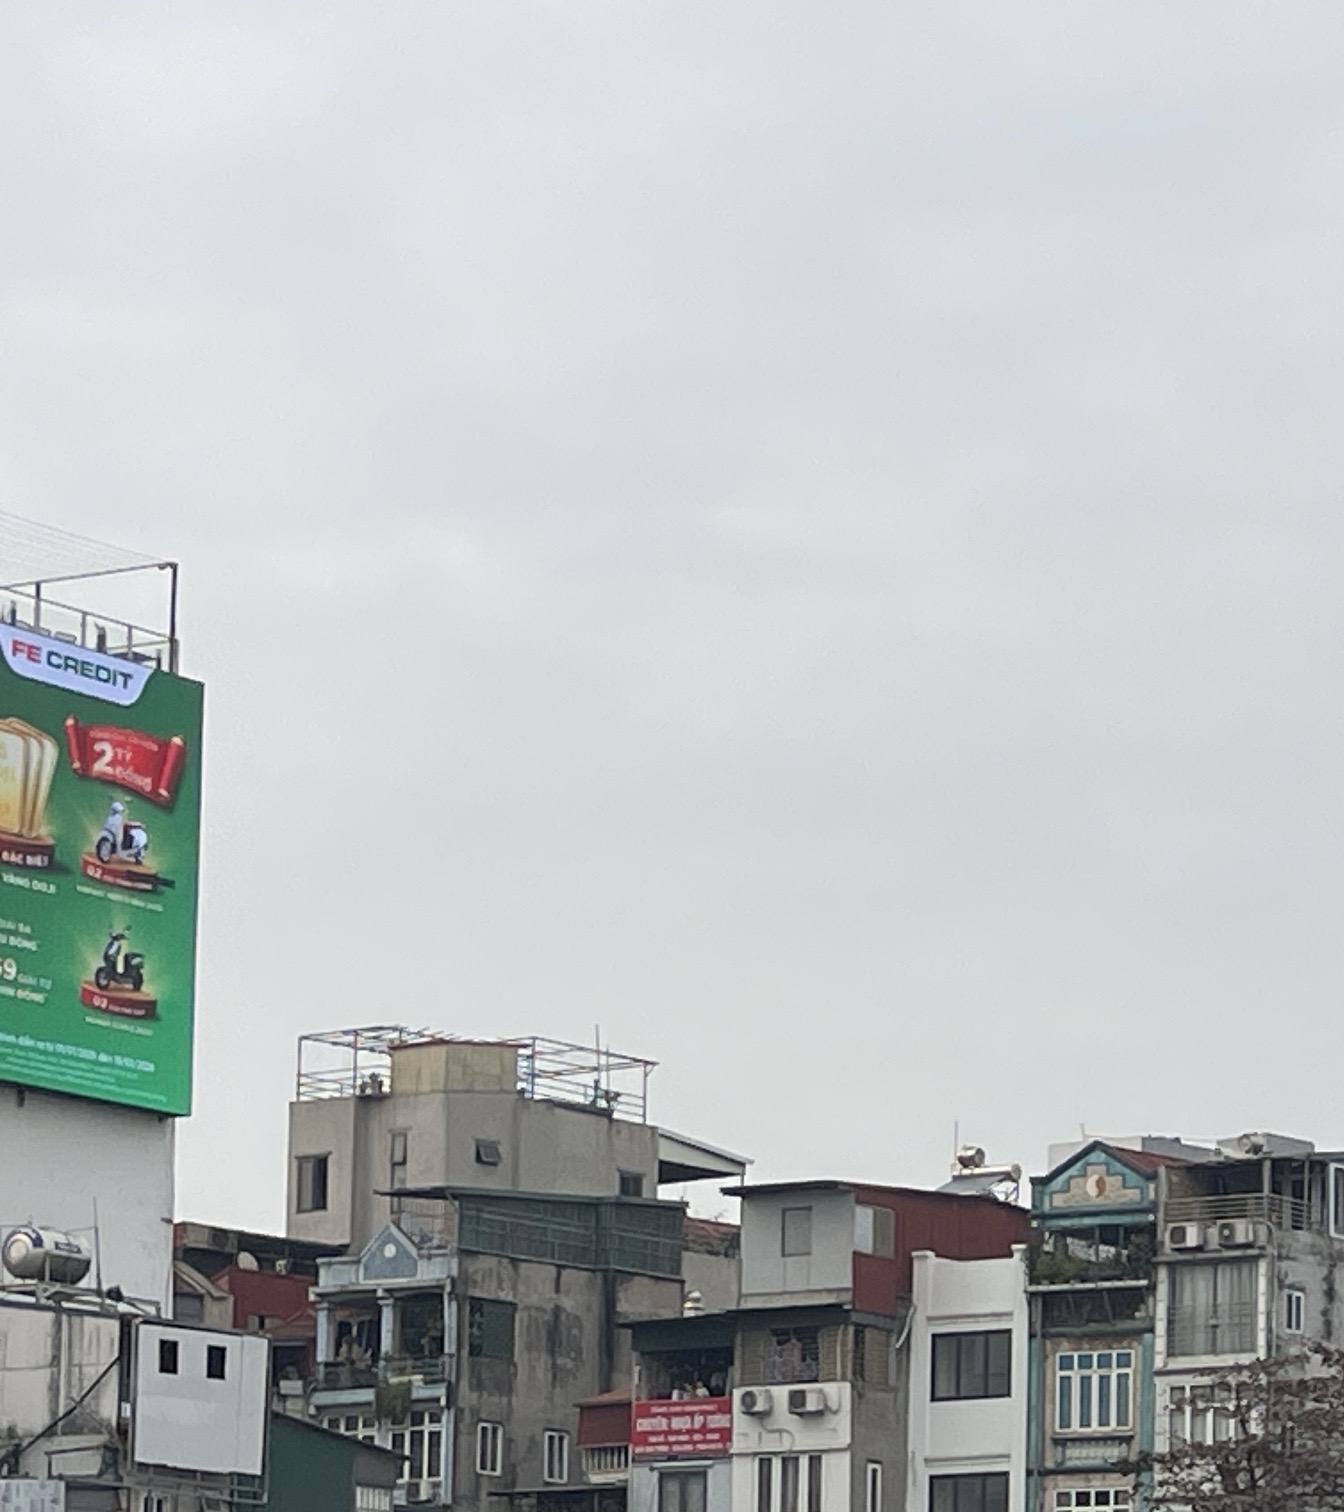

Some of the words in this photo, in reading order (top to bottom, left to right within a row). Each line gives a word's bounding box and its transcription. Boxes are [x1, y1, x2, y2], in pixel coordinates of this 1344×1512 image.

[11, 639, 42, 663] FE
[46, 650, 134, 690] CREDIT
[92, 741, 115, 775] 2
